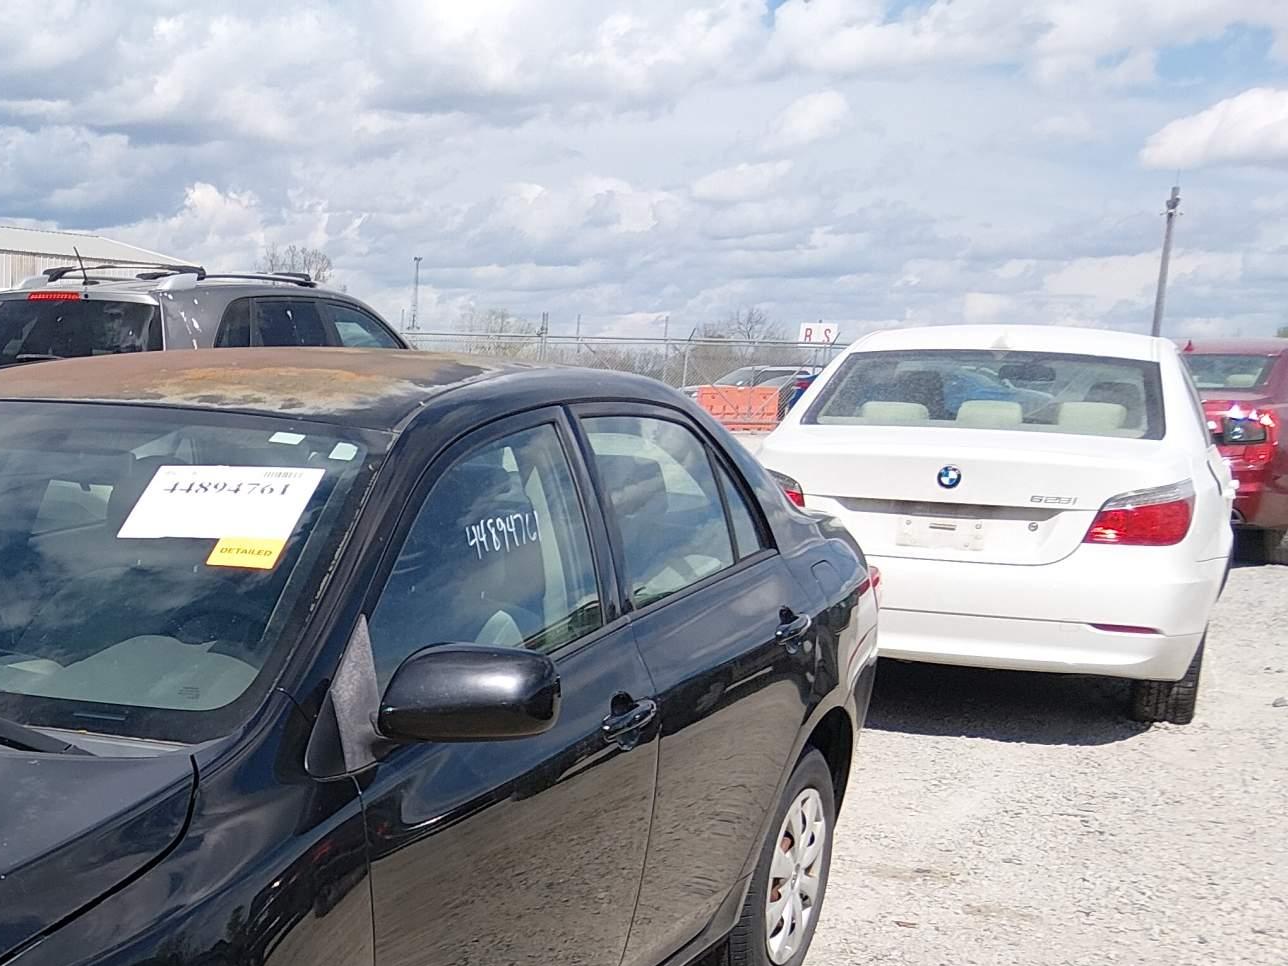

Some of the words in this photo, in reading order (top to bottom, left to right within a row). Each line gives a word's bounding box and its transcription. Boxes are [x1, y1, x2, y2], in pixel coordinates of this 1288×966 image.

[163, 481, 290, 495] 44894761
[465, 510, 543, 560] 44894761
[219, 547, 273, 557] DETAILED
